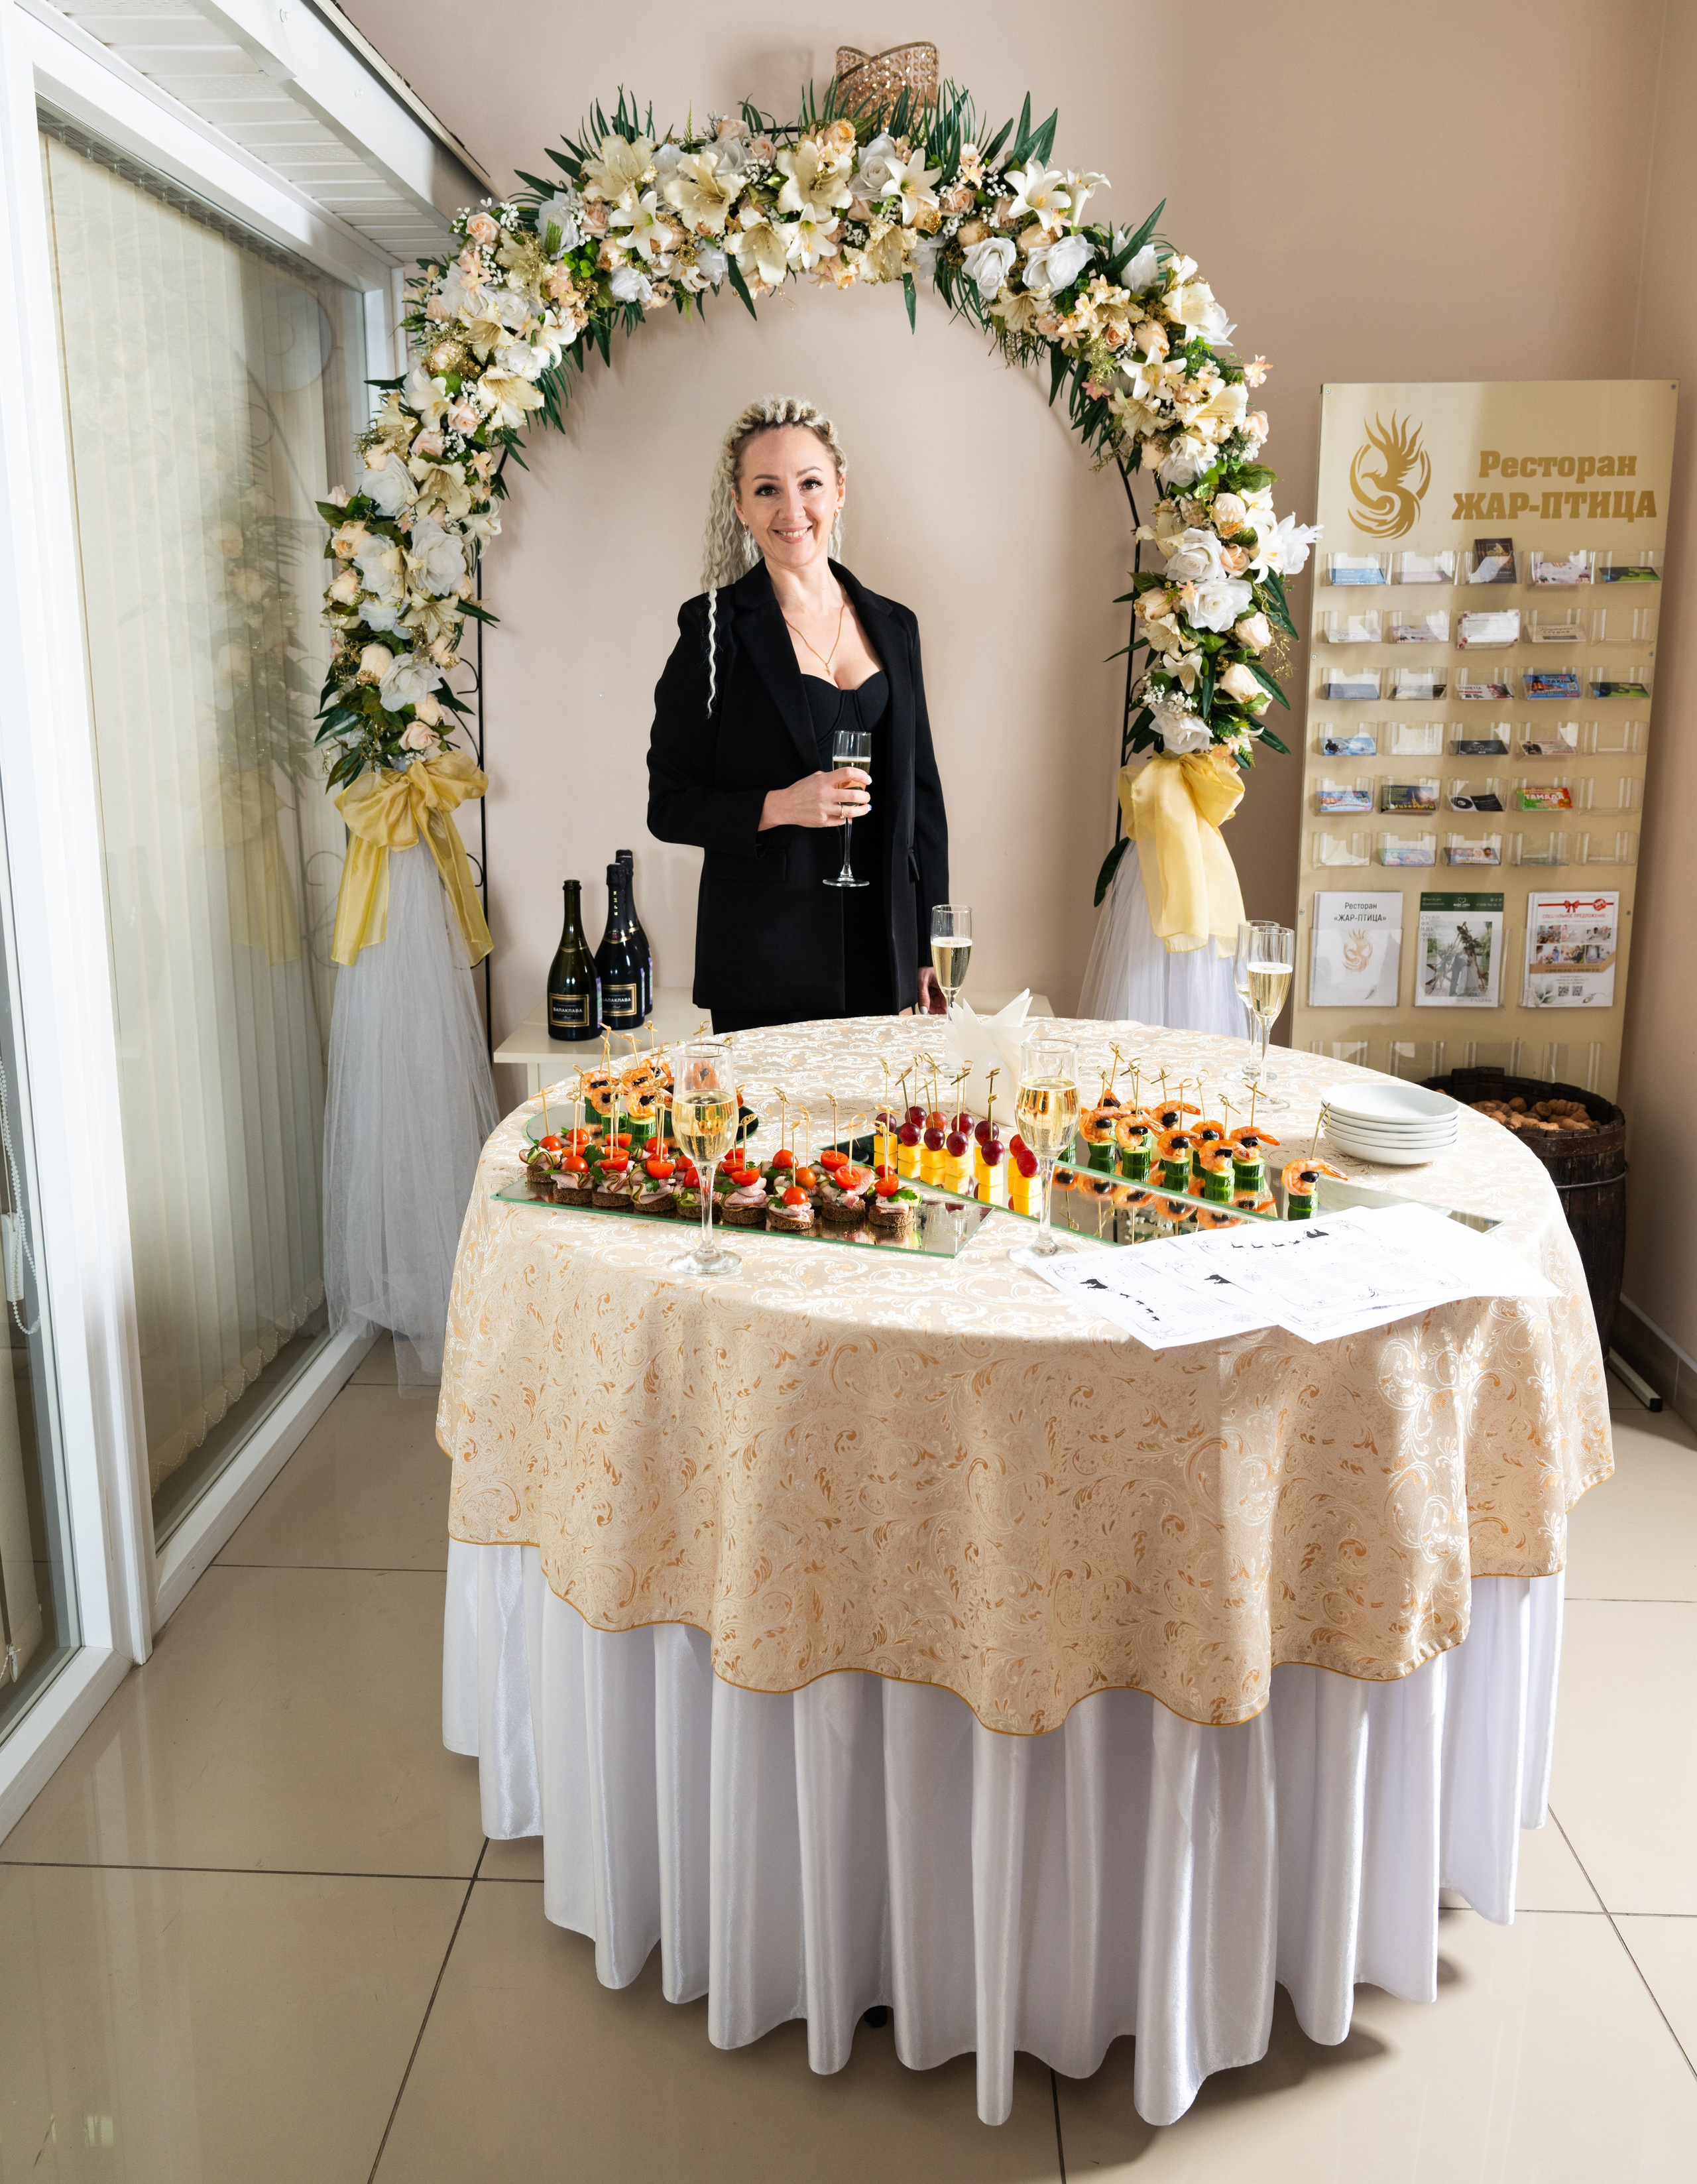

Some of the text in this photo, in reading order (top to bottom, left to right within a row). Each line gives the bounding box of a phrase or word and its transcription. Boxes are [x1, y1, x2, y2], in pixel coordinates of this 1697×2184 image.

[1478, 450, 1637, 483] Ресторан
[1451, 490, 1658, 523] ЖАР-ПТИЦА
[1344, 902, 1377, 911] Ресторан
[1334, 914, 1387, 922] «ЖАР-ПТИЦА»
